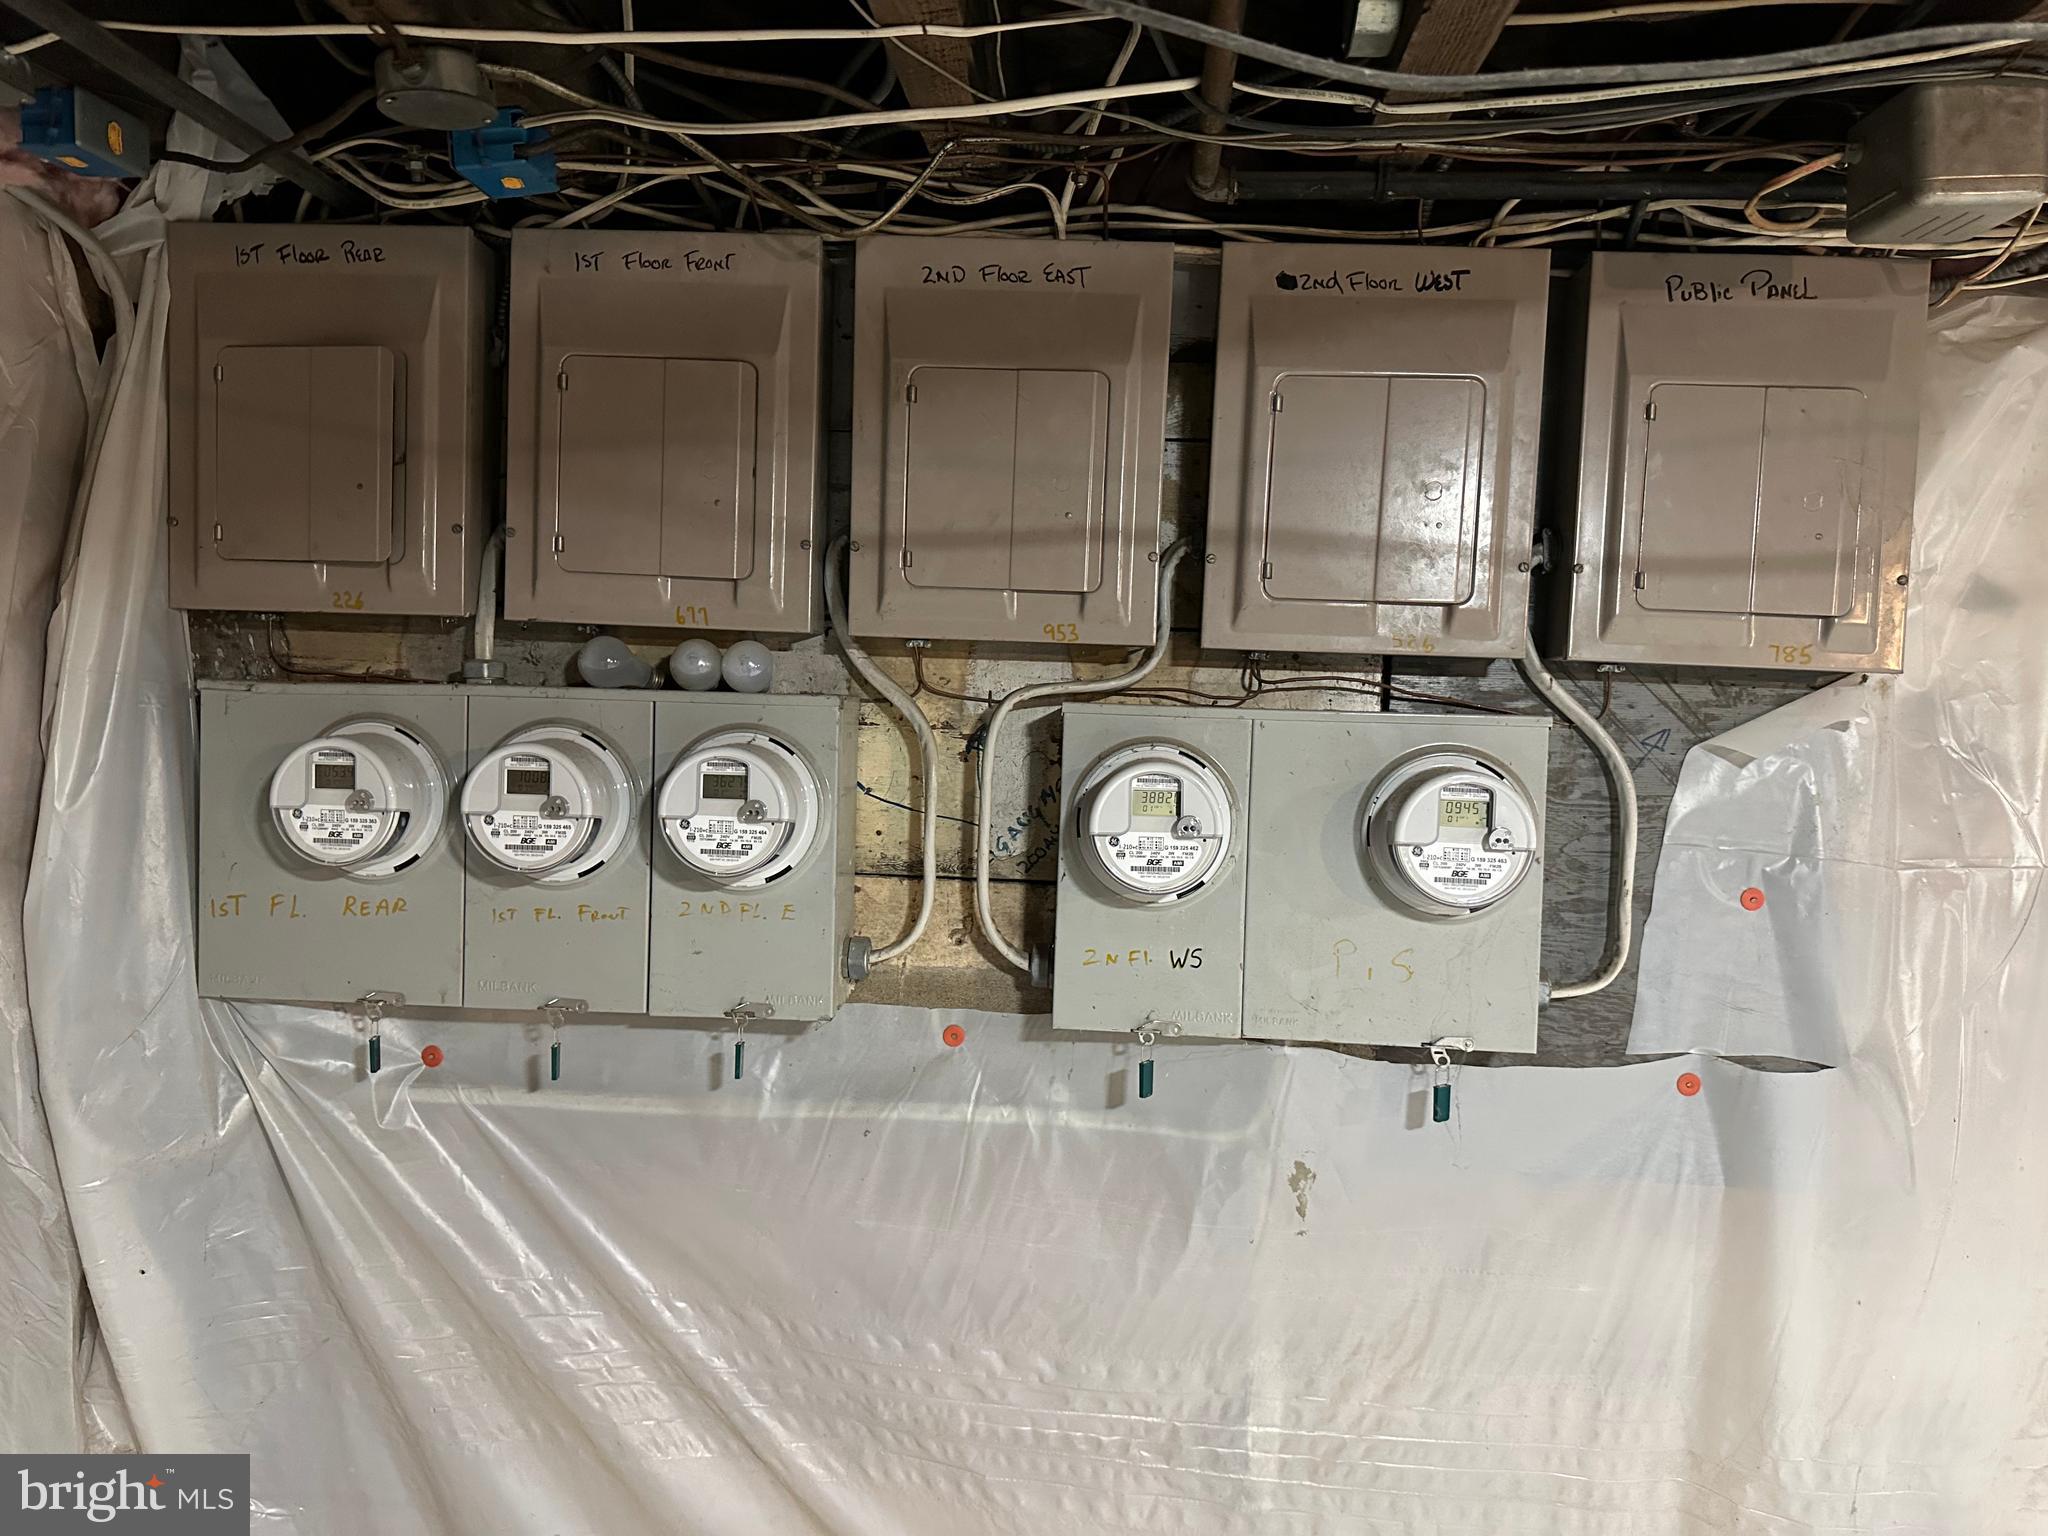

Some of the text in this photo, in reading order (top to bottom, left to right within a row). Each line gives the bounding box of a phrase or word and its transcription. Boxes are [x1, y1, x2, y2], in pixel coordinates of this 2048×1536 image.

[235, 243, 264, 267] 1ST
[575, 251, 605, 272] 1ST
[922, 265, 966, 284] 2ND
[1043, 262, 1092, 288] EAST
[1415, 269, 1471, 292] WEST
[332, 591, 364, 610] 226
[675, 605, 709, 626] 677
[1043, 622, 1080, 642] 953
[1768, 643, 1814, 665] 785
[1445, 801, 1479, 815] 0945
[328, 830, 344, 838] BGE
[209, 893, 248, 919] 1ST
[341, 895, 409, 918] REAR
[1169, 947, 1203, 969] WS
[477, 979, 537, 993] MILBANK
[1171, 1008, 1234, 1024] MILBANK
